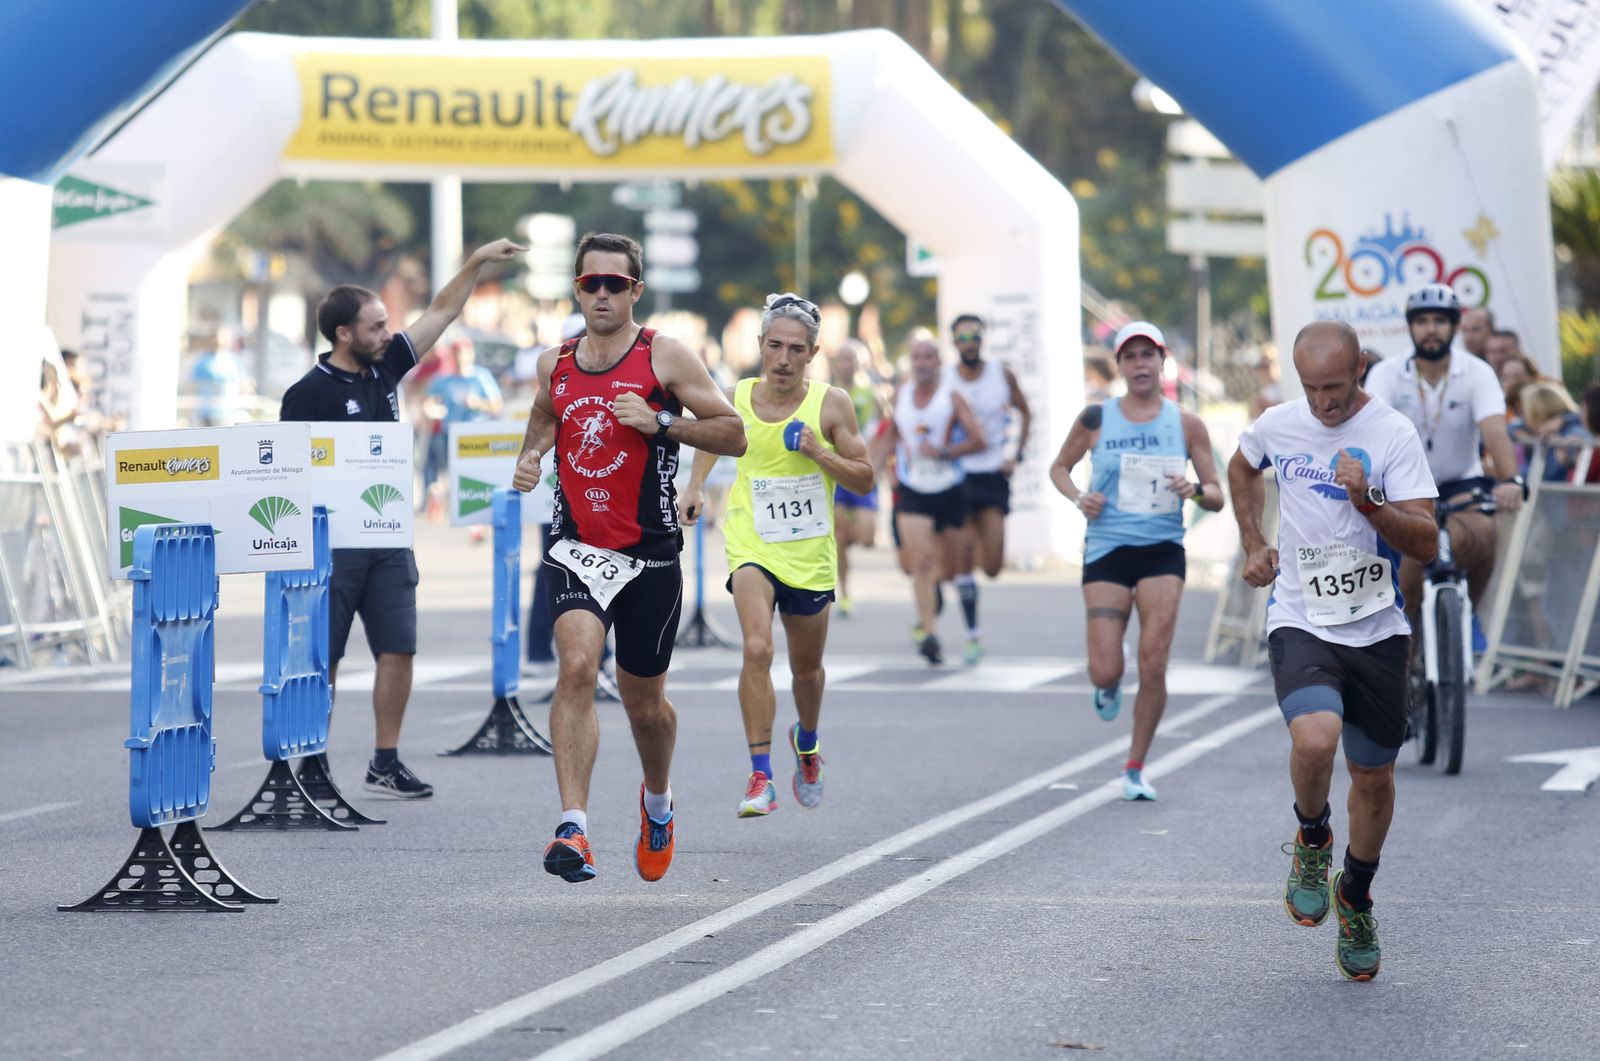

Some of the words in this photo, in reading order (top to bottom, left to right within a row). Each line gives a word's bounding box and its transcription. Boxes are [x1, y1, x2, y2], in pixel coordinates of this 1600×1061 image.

[319, 72, 574, 129] Renault
[561, 396, 617, 424] TRIATLO
[1105, 432, 1160, 451] nerja
[119, 459, 167, 473] Renault
[165, 456, 211, 477] Runners
[230, 468, 272, 476] Ayuntamiento
[281, 466, 304, 474] Málaga
[1279, 456, 1336, 483] Canier
[589, 490, 607, 499] KIA
[1151, 478, 1158, 495] 1
[766, 498, 813, 520] 1131
[363, 519, 401, 531] Unicaja
[252, 537, 298, 551] Unicaja
[569, 548, 620, 580] 6673
[1309, 563, 1384, 598] 13579
